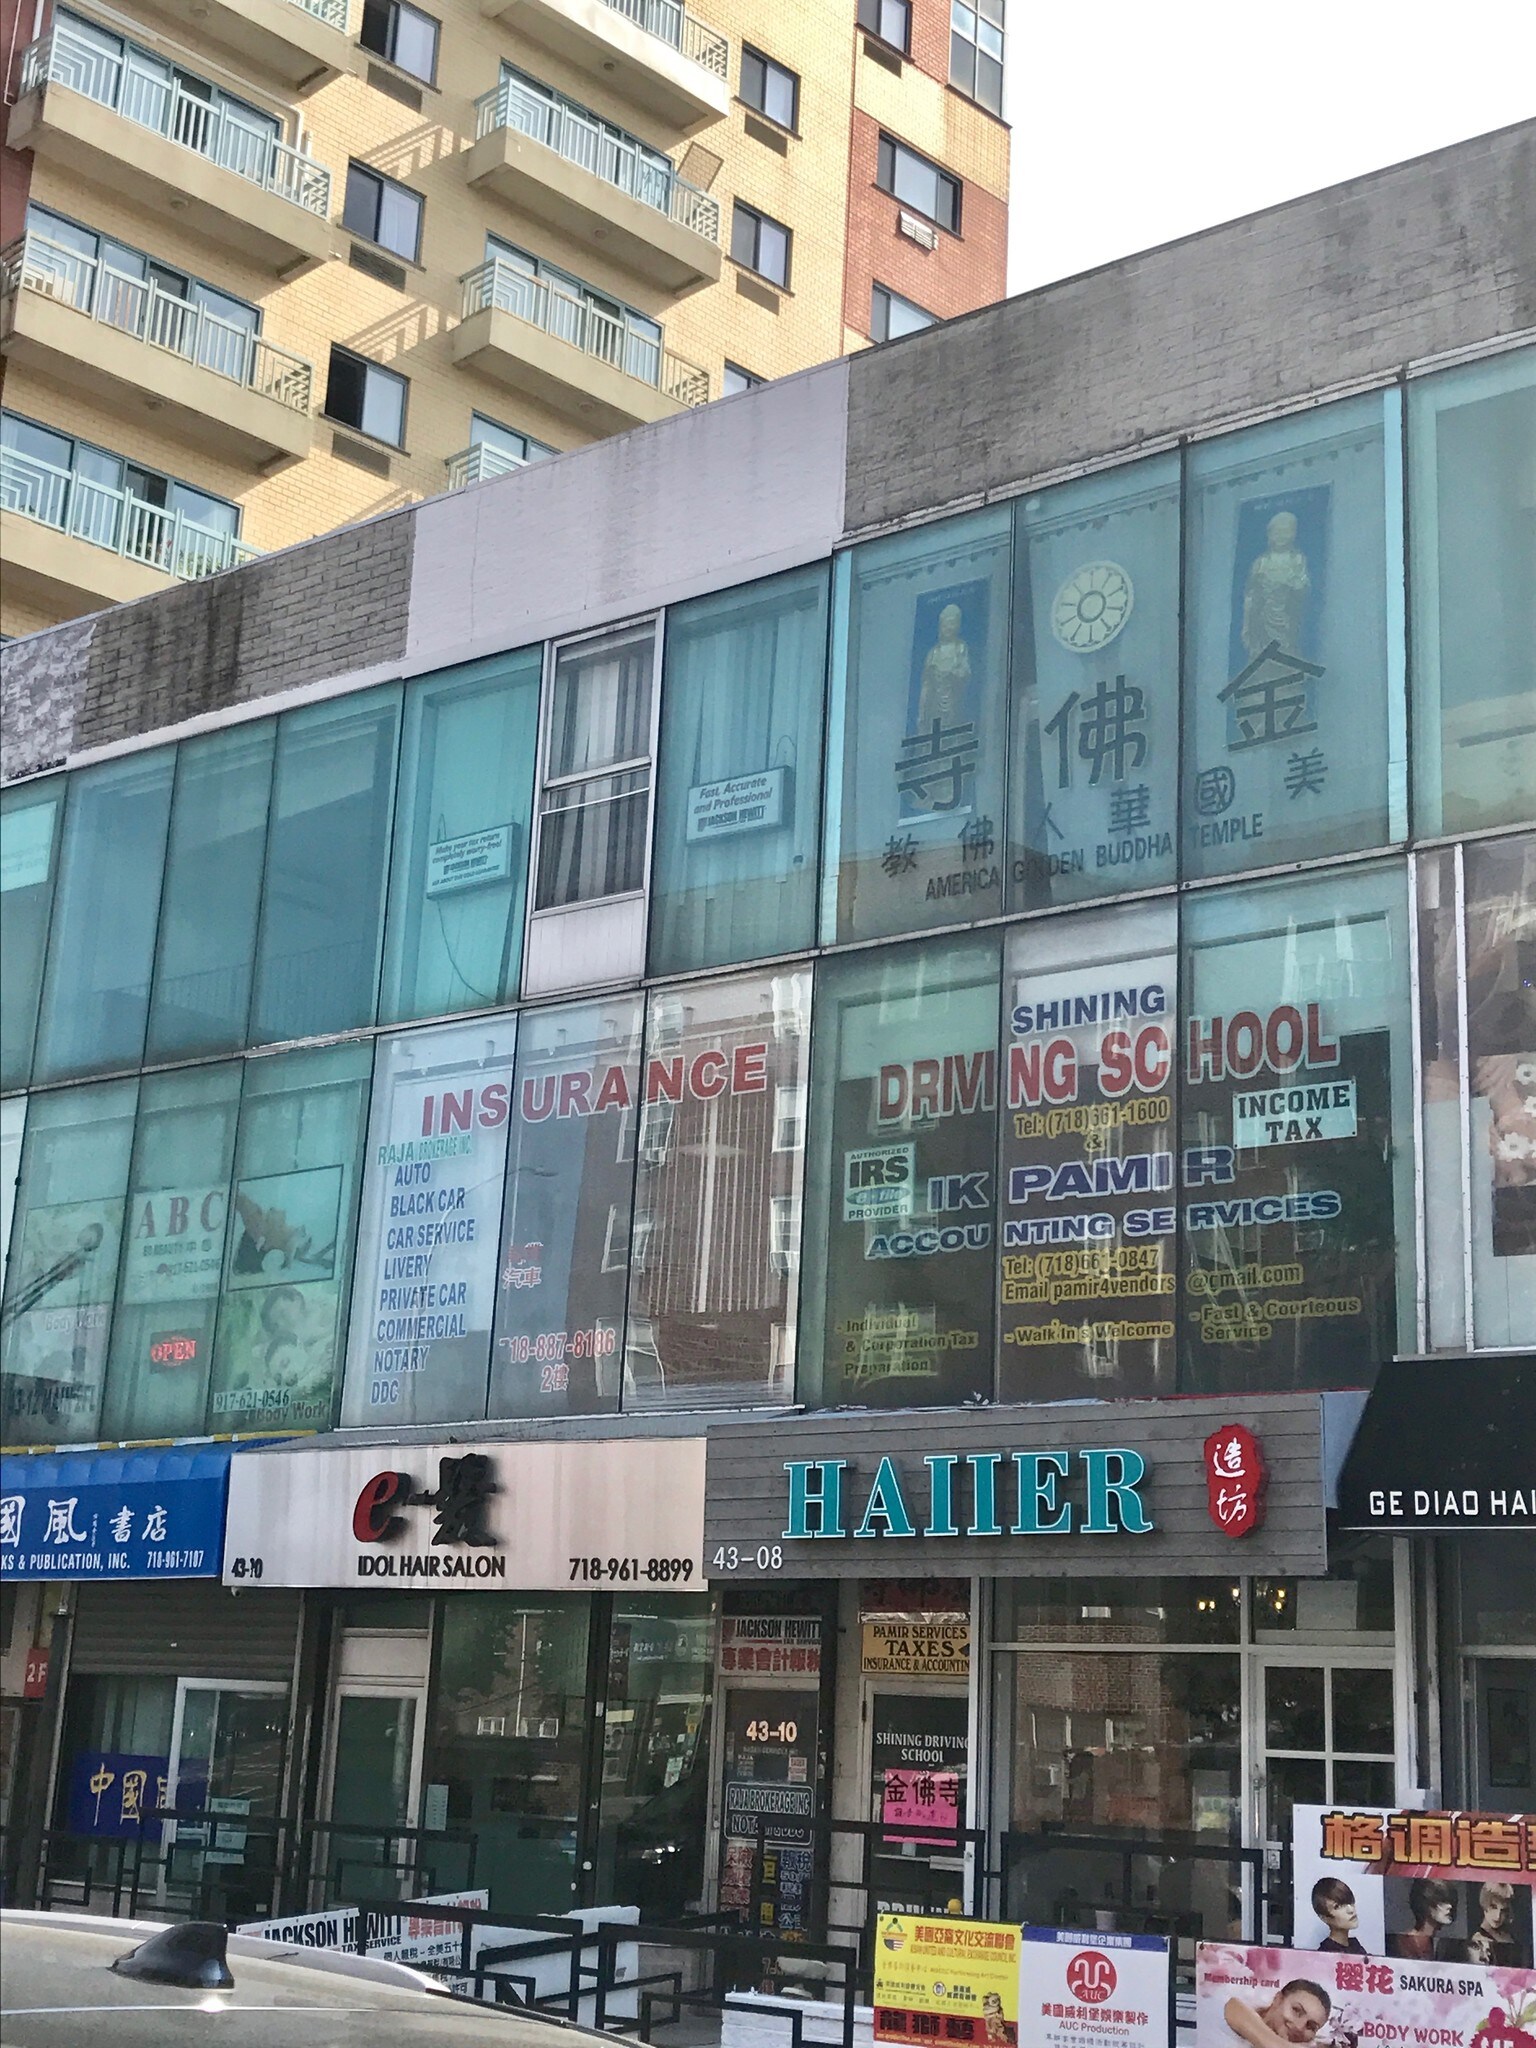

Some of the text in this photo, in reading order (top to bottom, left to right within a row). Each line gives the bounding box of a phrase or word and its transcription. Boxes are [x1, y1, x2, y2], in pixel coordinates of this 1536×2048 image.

[723, 778, 767, 794] Accurate
[694, 787, 773, 814] and Professional
[926, 813, 1263, 900] AMERICA GDEN BUDDHA TEMPLE
[1011, 984, 1166, 1035] SHINING
[877, 1002, 1341, 1125] DRIVING SCHOOL
[420, 1043, 769, 1138] INSURANCE
[1238, 1084, 1350, 1119] INCOME
[1015, 1114, 1042, 1137] Tel:
[1265, 1116, 1323, 1143] TAX
[378, 1142, 414, 1165] RAJA
[850, 1147, 909, 1160] AUTHORIZED
[394, 1162, 431, 1186] AUTO
[849, 1155, 909, 1188] IRS
[1007, 1145, 1236, 1204] PAMIR
[390, 1187, 465, 1217] BLACK CAR
[848, 1204, 908, 1219] PROVIDER
[387, 1219, 475, 1250] CAR SERVICE
[864, 1190, 1342, 1260] ACCOUNTING SERVICES
[384, 1253, 432, 1281] LIVERY
[1005, 1256, 1033, 1277] Tel:
[379, 1282, 467, 1311] PRIVATE CAR
[1004, 1280, 1049, 1300] Email
[1203, 1299, 1358, 1321] Fast & Courteous
[377, 1313, 467, 1342] COMMERCIAL
[846, 1314, 917, 1332] Individual
[1096, 1322, 1172, 1339] Welcome
[1203, 1325, 1270, 1341] Service
[952, 1331, 975, 1346] Tax
[151, 1340, 196, 1362] OPEN
[374, 1346, 430, 1374] NOTARY
[371, 1379, 399, 1405] DDC
[294, 1400, 328, 1420] Work
[1213, 1437, 1247, 1526] 造坊
[1369, 1490, 1403, 1515] GE
[1414, 1489, 1478, 1515] DIAO
[18, 1554, 25, 1570] &
[30, 1552, 103, 1571] PUBLICATION,
[108, 1552, 130, 1570] INC.
[357, 1555, 505, 1577] IDOL HAIR SALON
[569, 1557, 693, 1582] 718-961-8899
[712, 1545, 783, 1571] 43-08
[736, 1618, 821, 1638] JACKSON HEWITT
[873, 1626, 967, 1639] PAMIR SERVICES
[884, 1640, 955, 1657] TAXES
[26, 1662, 48, 1683] 2F
[863, 1657, 911, 1671] INSURANCE
[913, 1660, 920, 1671] &
[746, 1720, 798, 1743] 43-10
[876, 1732, 922, 1747] SHINING
[901, 1748, 944, 1762] SCHOOL
[885, 1774, 959, 1808] 金佛寺
[364, 1936, 402, 1949] SERVICE
[1203, 1972, 1280, 1990] Membership card
[1335, 1961, 1394, 1995] 樱花
[1399, 1974, 1484, 1998] SAKURA SPA
[1058, 2020, 1130, 2037] AUC Production
[1362, 2021, 1409, 2042] BODY
[1413, 2027, 1465, 2047] WORK
